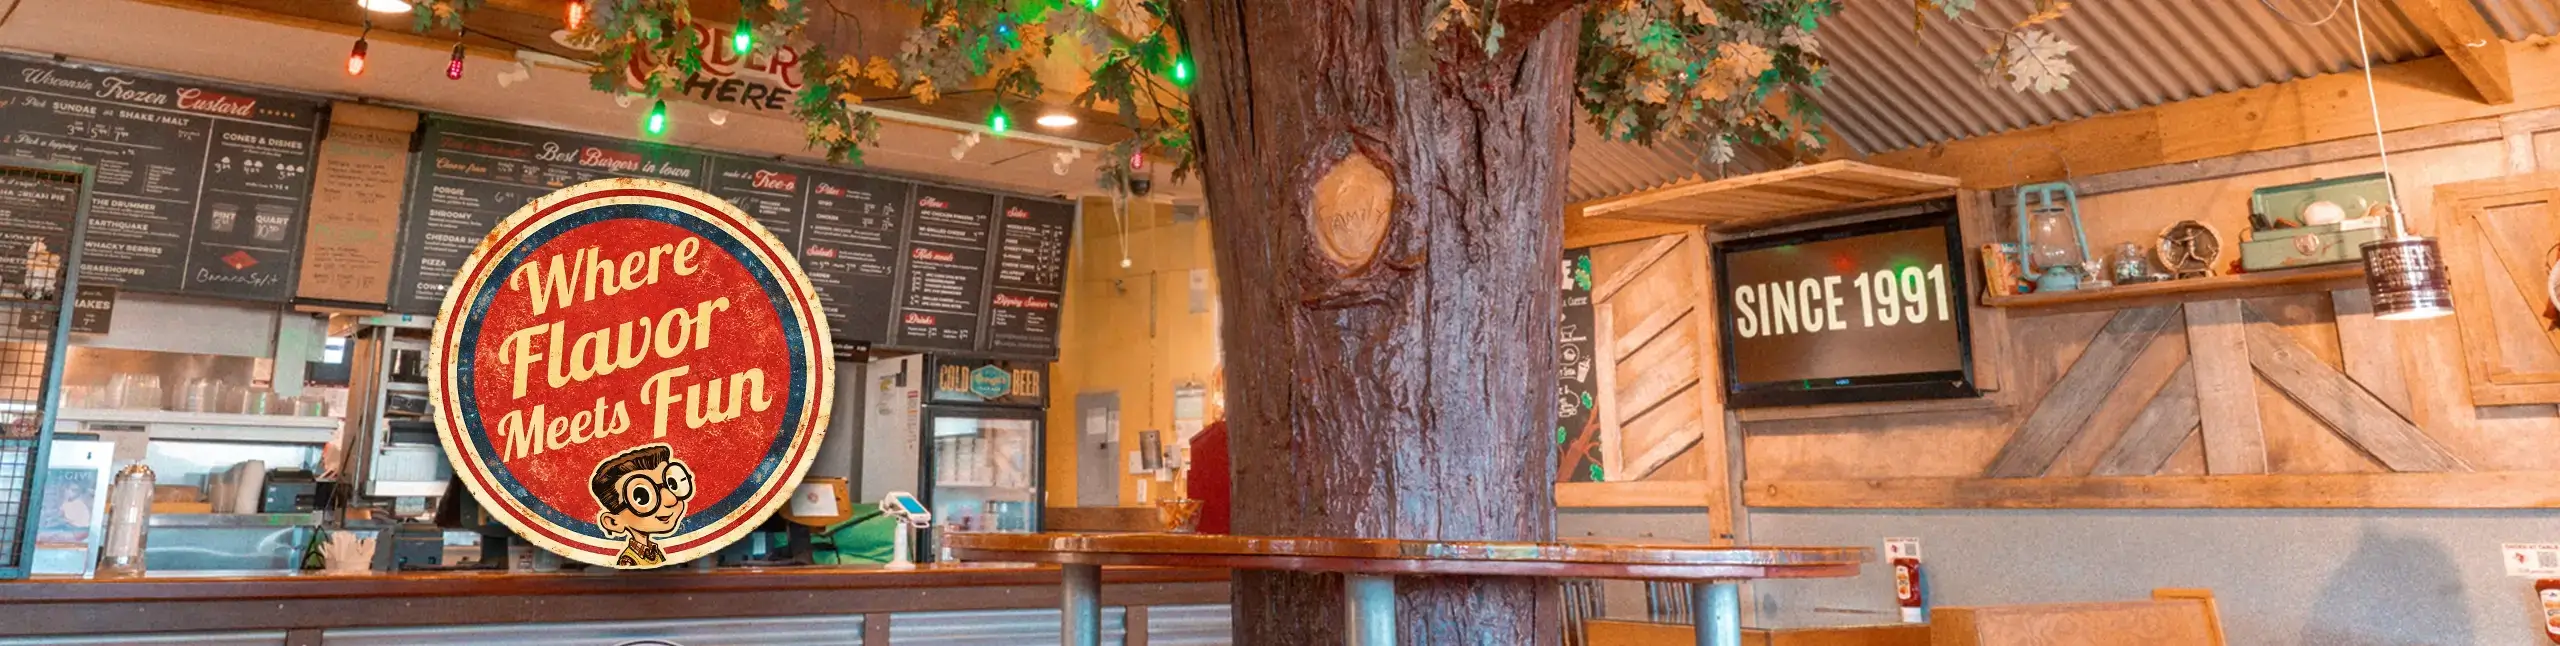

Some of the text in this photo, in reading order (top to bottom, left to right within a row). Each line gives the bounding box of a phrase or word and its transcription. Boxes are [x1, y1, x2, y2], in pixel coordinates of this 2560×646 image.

[21, 67, 256, 117] Wisconsin Frozen Custard
[683, 72, 792, 110] HERE
[52, 101, 97, 114] SUNDAE
[222, 132, 257, 144] CONES
[259, 137, 266, 145] &
[268, 138, 303, 149] DISHES
[535, 142, 580, 163] Best
[579, 147, 641, 172] Burgers
[642, 160, 655, 173] in
[659, 162, 691, 177] town
[92, 198, 156, 210] THE DRUMMER
[213, 211, 237, 220] PINT
[255, 216, 289, 225] QUART
[429, 209, 472, 219] SHROOMY
[88, 219, 149, 230] EARTHQUAKE
[425, 233, 466, 243] CHEDDAR
[84, 241, 163, 254] WHACKY BERRIES
[421, 257, 446, 267] PIZZA
[80, 264, 145, 276] GRASSHOPPER
[250, 272, 278, 287] Split
[1735, 264, 1949, 338] SINCE 1991
[940, 364, 969, 392] COLD
[1012, 369, 1039, 396] BEER
